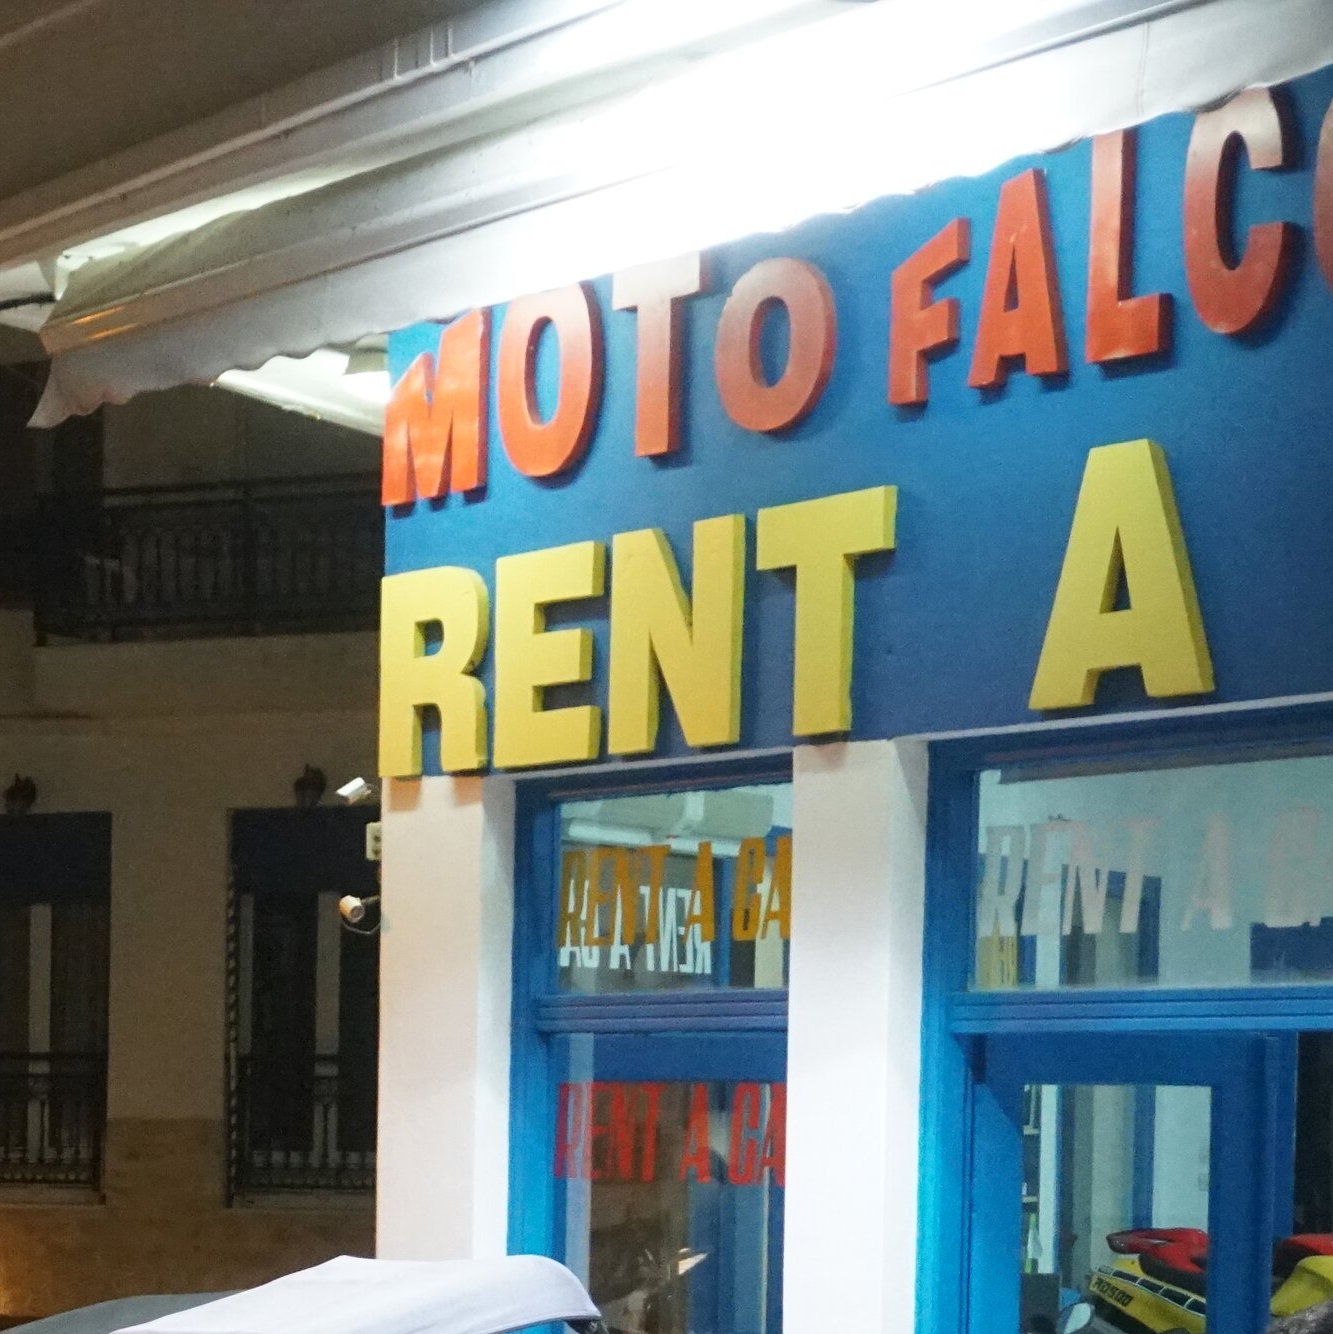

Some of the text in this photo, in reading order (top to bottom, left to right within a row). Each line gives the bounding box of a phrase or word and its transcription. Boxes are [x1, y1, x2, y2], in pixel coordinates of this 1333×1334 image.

[381, 86, 1333, 506] MOTO FALC
[379, 438, 1214, 778] RENT A
[558, 845, 671, 947] RENT
[685, 841, 715, 942] A
[977, 818, 1164, 937] RENT
[1182, 810, 1232, 931] A
[554, 1082, 671, 1182] RENT
[679, 1082, 711, 1183] A
